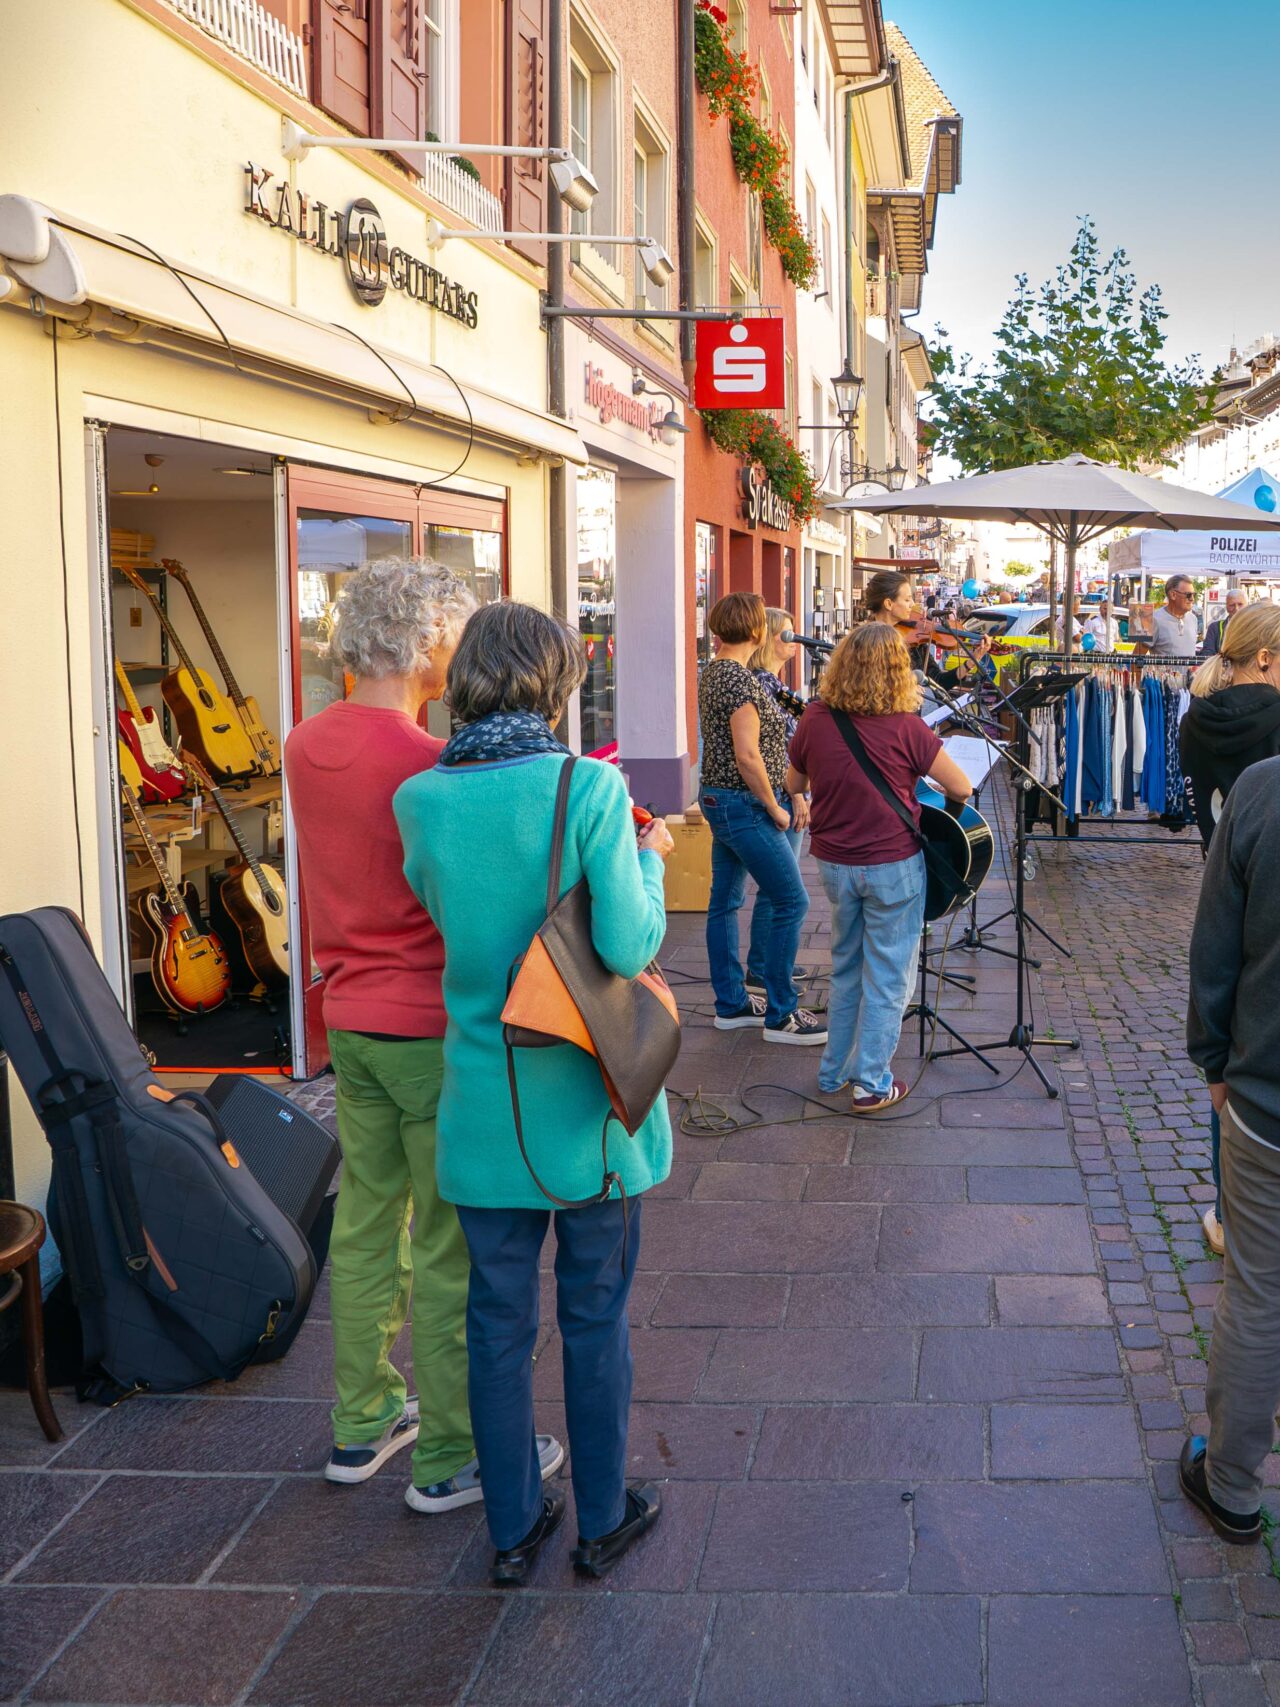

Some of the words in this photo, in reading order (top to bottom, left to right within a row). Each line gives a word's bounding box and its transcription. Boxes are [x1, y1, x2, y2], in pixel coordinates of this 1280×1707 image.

[246, 161, 347, 258] KALLI
[388, 246, 478, 330] GUITARS
[744, 466, 791, 532] Spakasse
[1210, 537, 1257, 553] POLIZEI
